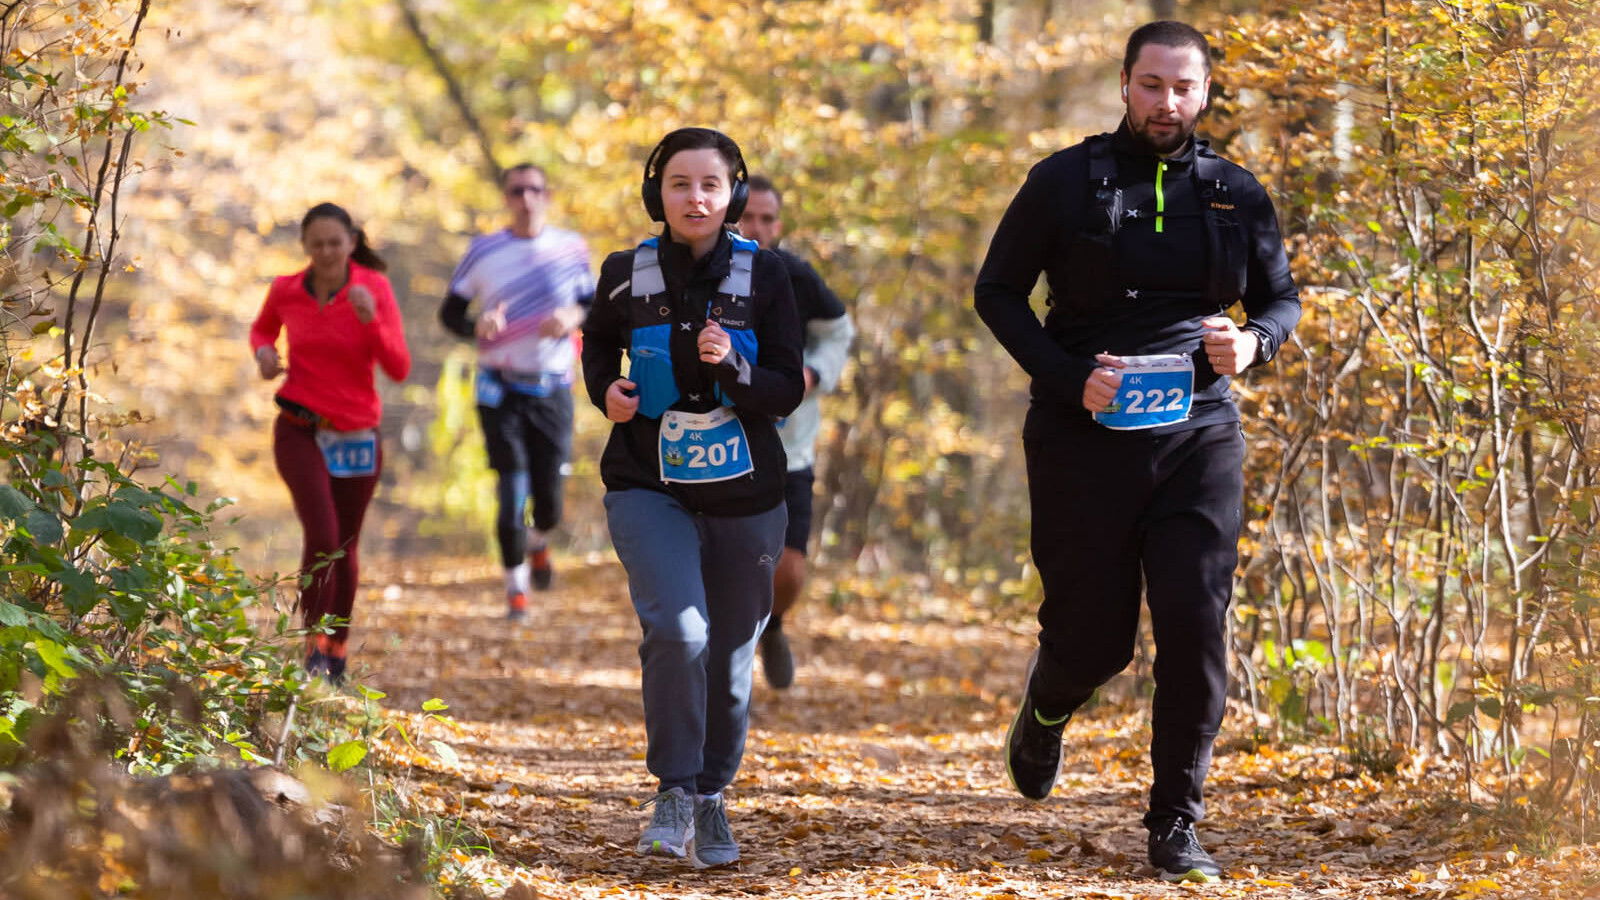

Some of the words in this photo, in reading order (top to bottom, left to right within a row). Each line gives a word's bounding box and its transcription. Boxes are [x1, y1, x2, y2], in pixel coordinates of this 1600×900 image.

[1129, 376, 1143, 385] 4K
[1125, 387, 1185, 414] 222
[689, 432, 703, 441] 4K
[333, 446, 370, 466] 113
[687, 436, 740, 468] 207
